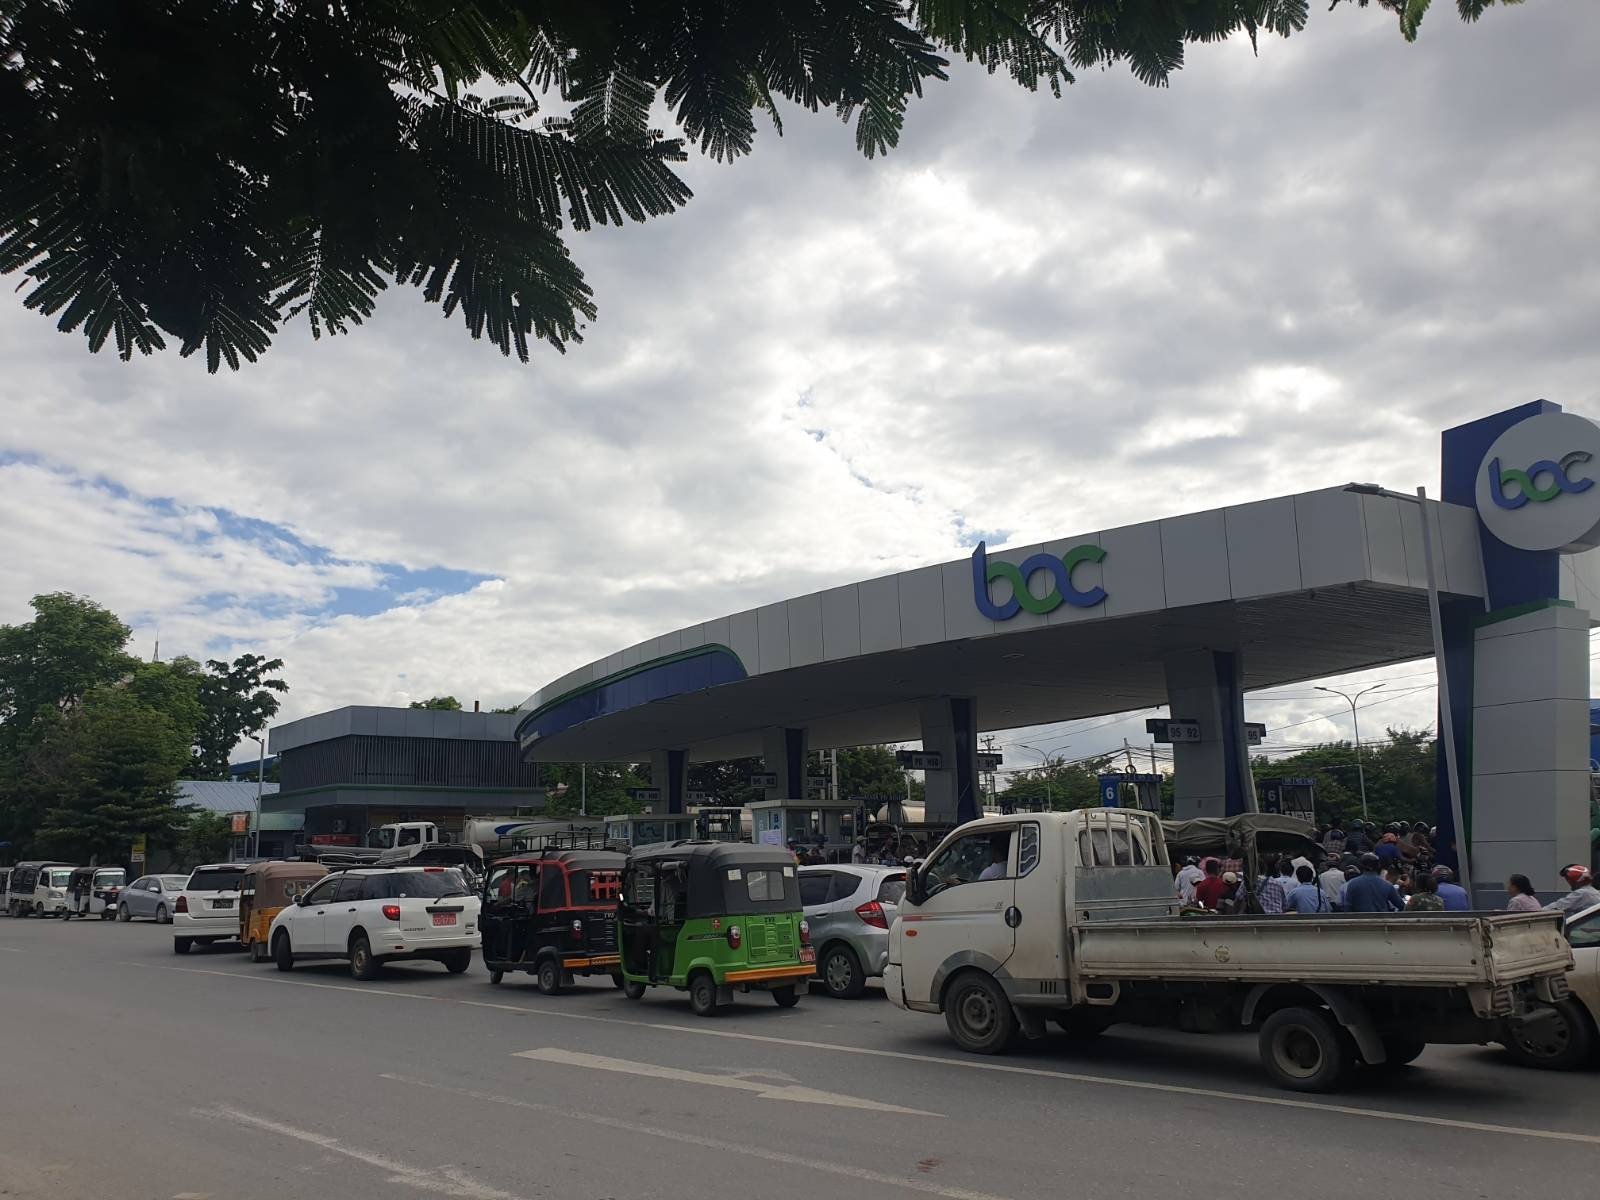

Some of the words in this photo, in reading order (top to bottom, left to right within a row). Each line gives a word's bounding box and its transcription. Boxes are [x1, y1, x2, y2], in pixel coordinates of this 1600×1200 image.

[1488, 451, 1594, 509] boc
[972, 541, 1107, 620] boc
[1171, 728, 1181, 737] 95
[1187, 728, 1198, 738] 92
[1106, 787, 1114, 799] 6
[1268, 790, 1276, 801] 6
